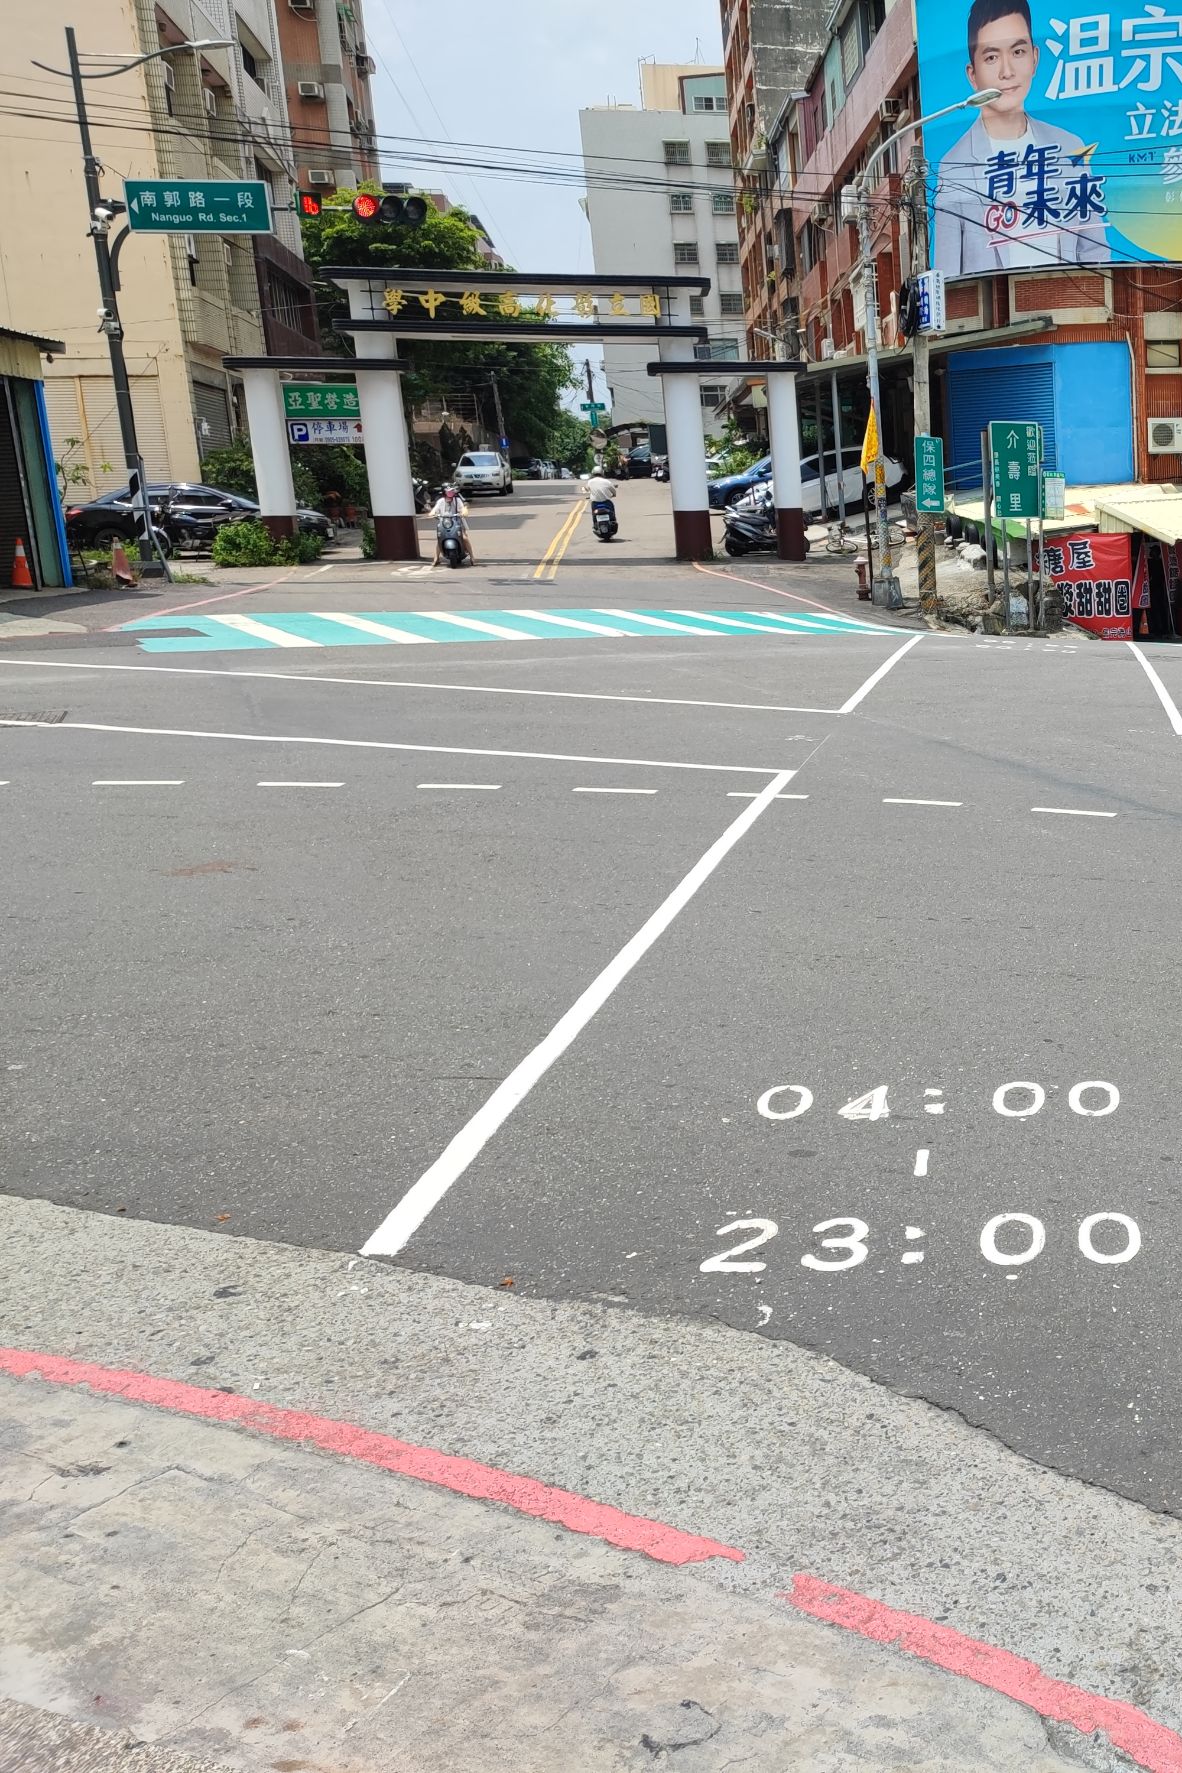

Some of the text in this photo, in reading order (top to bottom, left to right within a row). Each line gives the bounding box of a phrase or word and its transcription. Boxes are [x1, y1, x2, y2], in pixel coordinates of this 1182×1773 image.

[984, 144, 1061, 200] 青年
[139, 191, 254, 208] 南郭路一段
[151, 213, 247, 223] Nanguo Rd. Sec.1
[985, 173, 1106, 233] GO 未來
[288, 392, 359, 410] 亞聖營造
[312, 421, 349, 434] 停車場
[922, 440, 937, 496] 保四總隊
[1006, 429, 1022, 512] 介壽里
